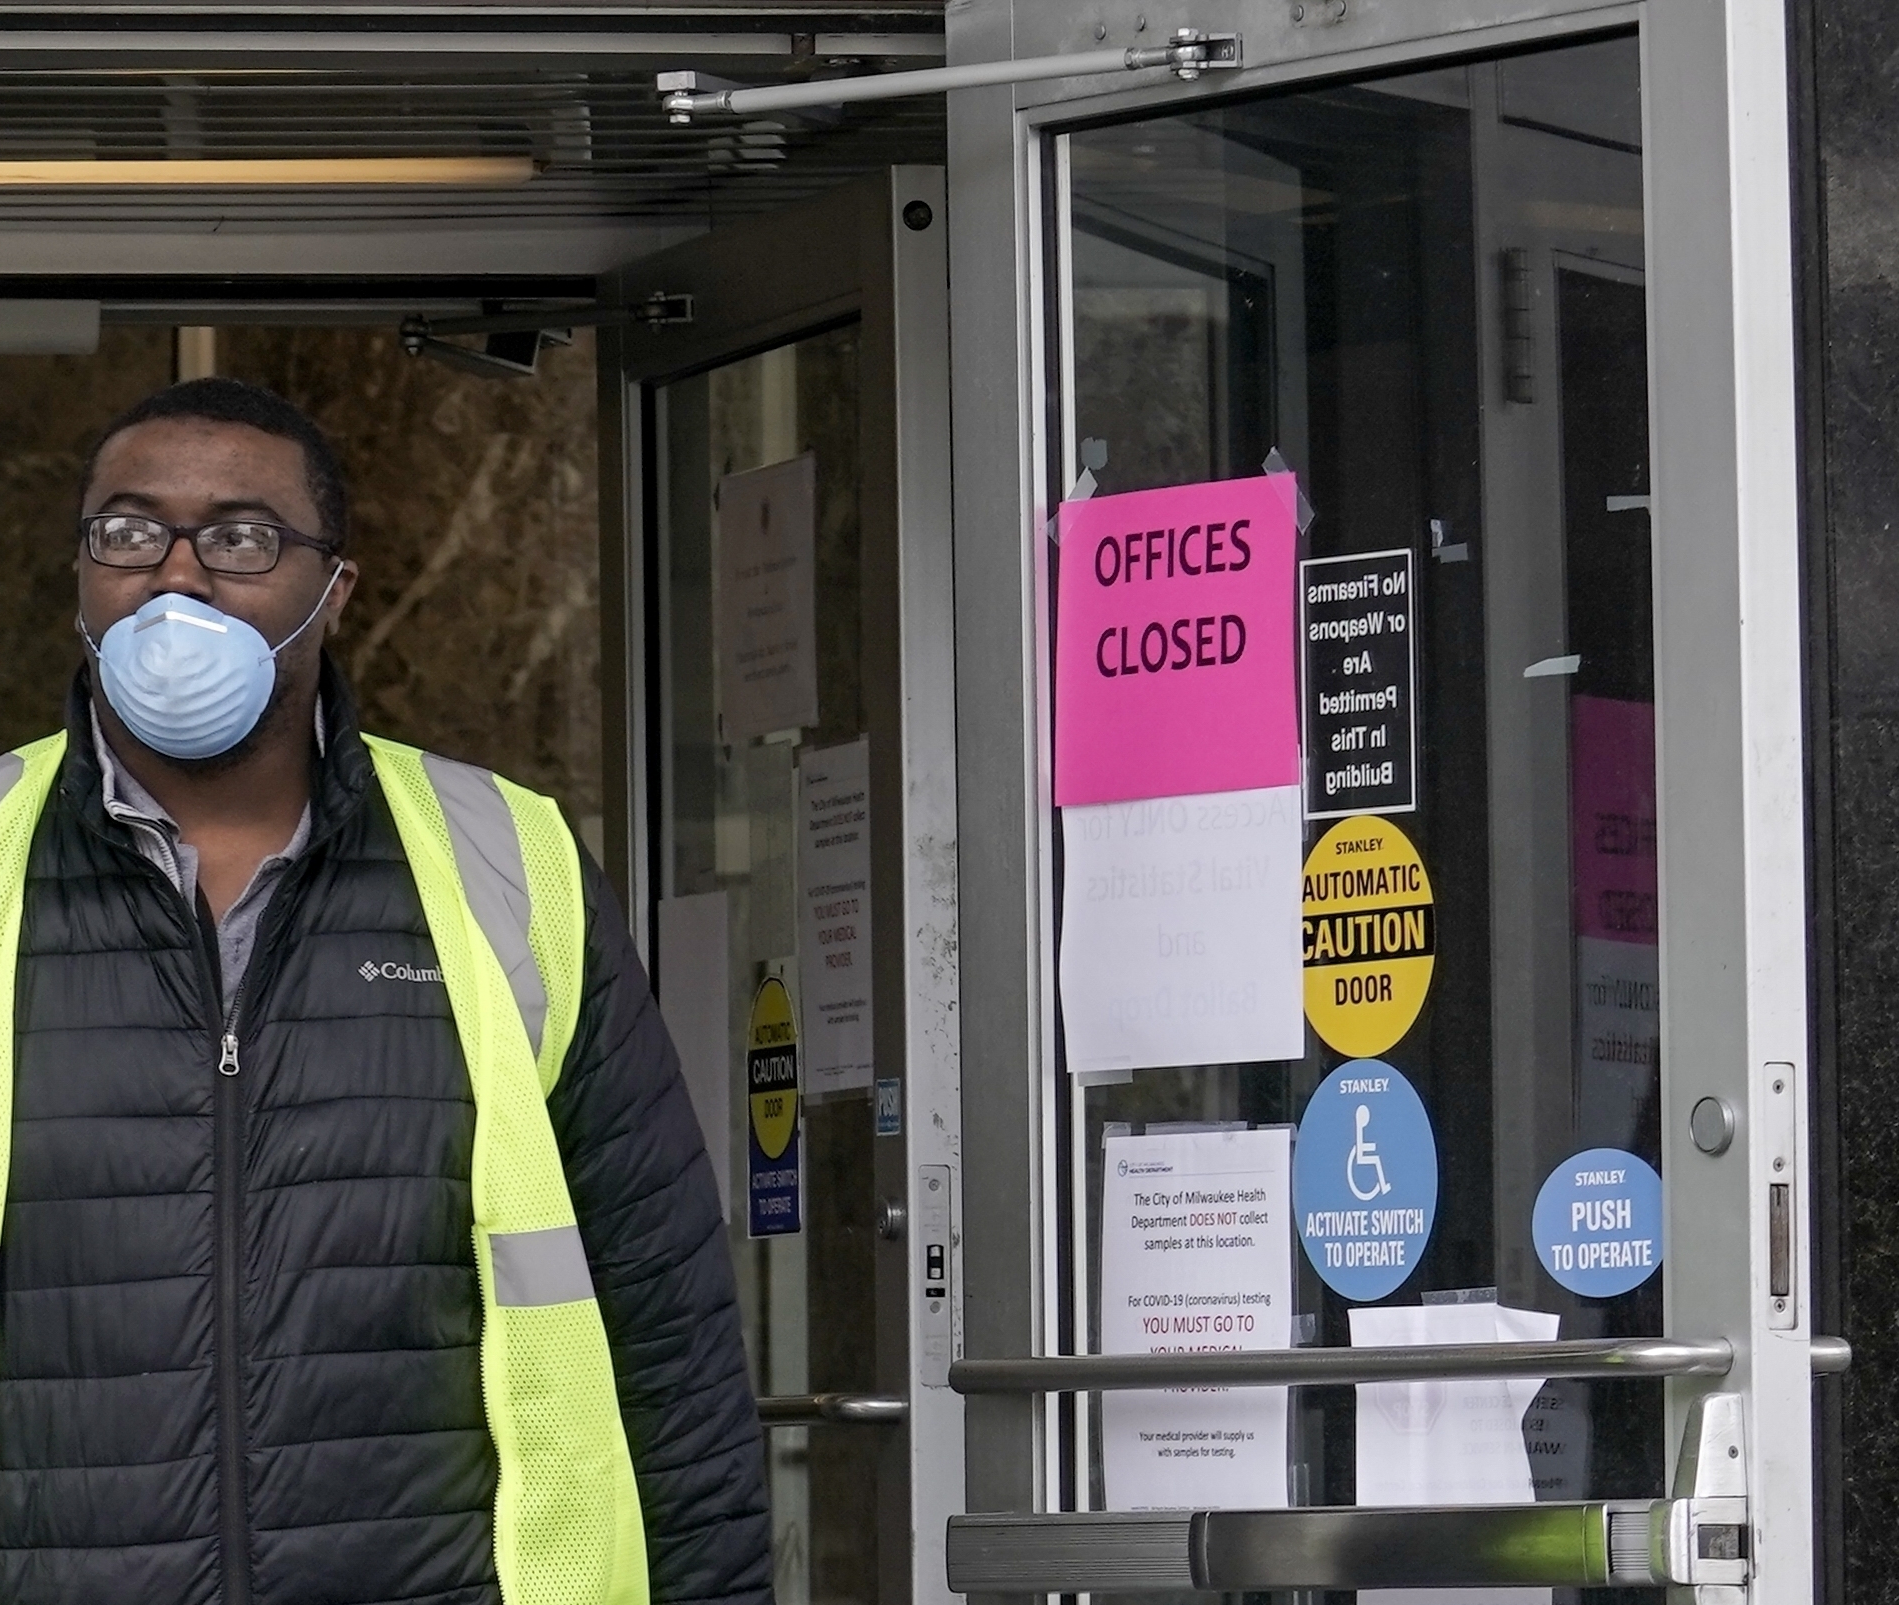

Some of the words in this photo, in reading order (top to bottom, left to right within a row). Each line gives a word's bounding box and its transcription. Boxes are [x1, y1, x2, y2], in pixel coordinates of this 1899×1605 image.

[1095, 520, 1250, 587] OFFICES
[1097, 615, 1246, 677] CLOSED
[1303, 863, 1420, 902] AUTOMATIC
[1302, 910, 1425, 961] CAUTION
[381, 962, 445, 983] Columb
[1335, 974, 1393, 1007] DOOR
[753, 1055, 794, 1084] CAUTION
[1340, 1078, 1389, 1093] STANLEY
[764, 1098, 783, 1118] DOOR
[1575, 1170, 1625, 1186] STANLEY
[1306, 1211, 1368, 1237] ACTIVATE
[1372, 1209, 1423, 1235] SWITCH
[1572, 1199, 1631, 1231] PUSH
[1325, 1243, 1342, 1267] TO
[1346, 1241, 1404, 1267] OPERATE
[1552, 1244, 1573, 1270] TO
[1578, 1240, 1652, 1269] OPERATE
